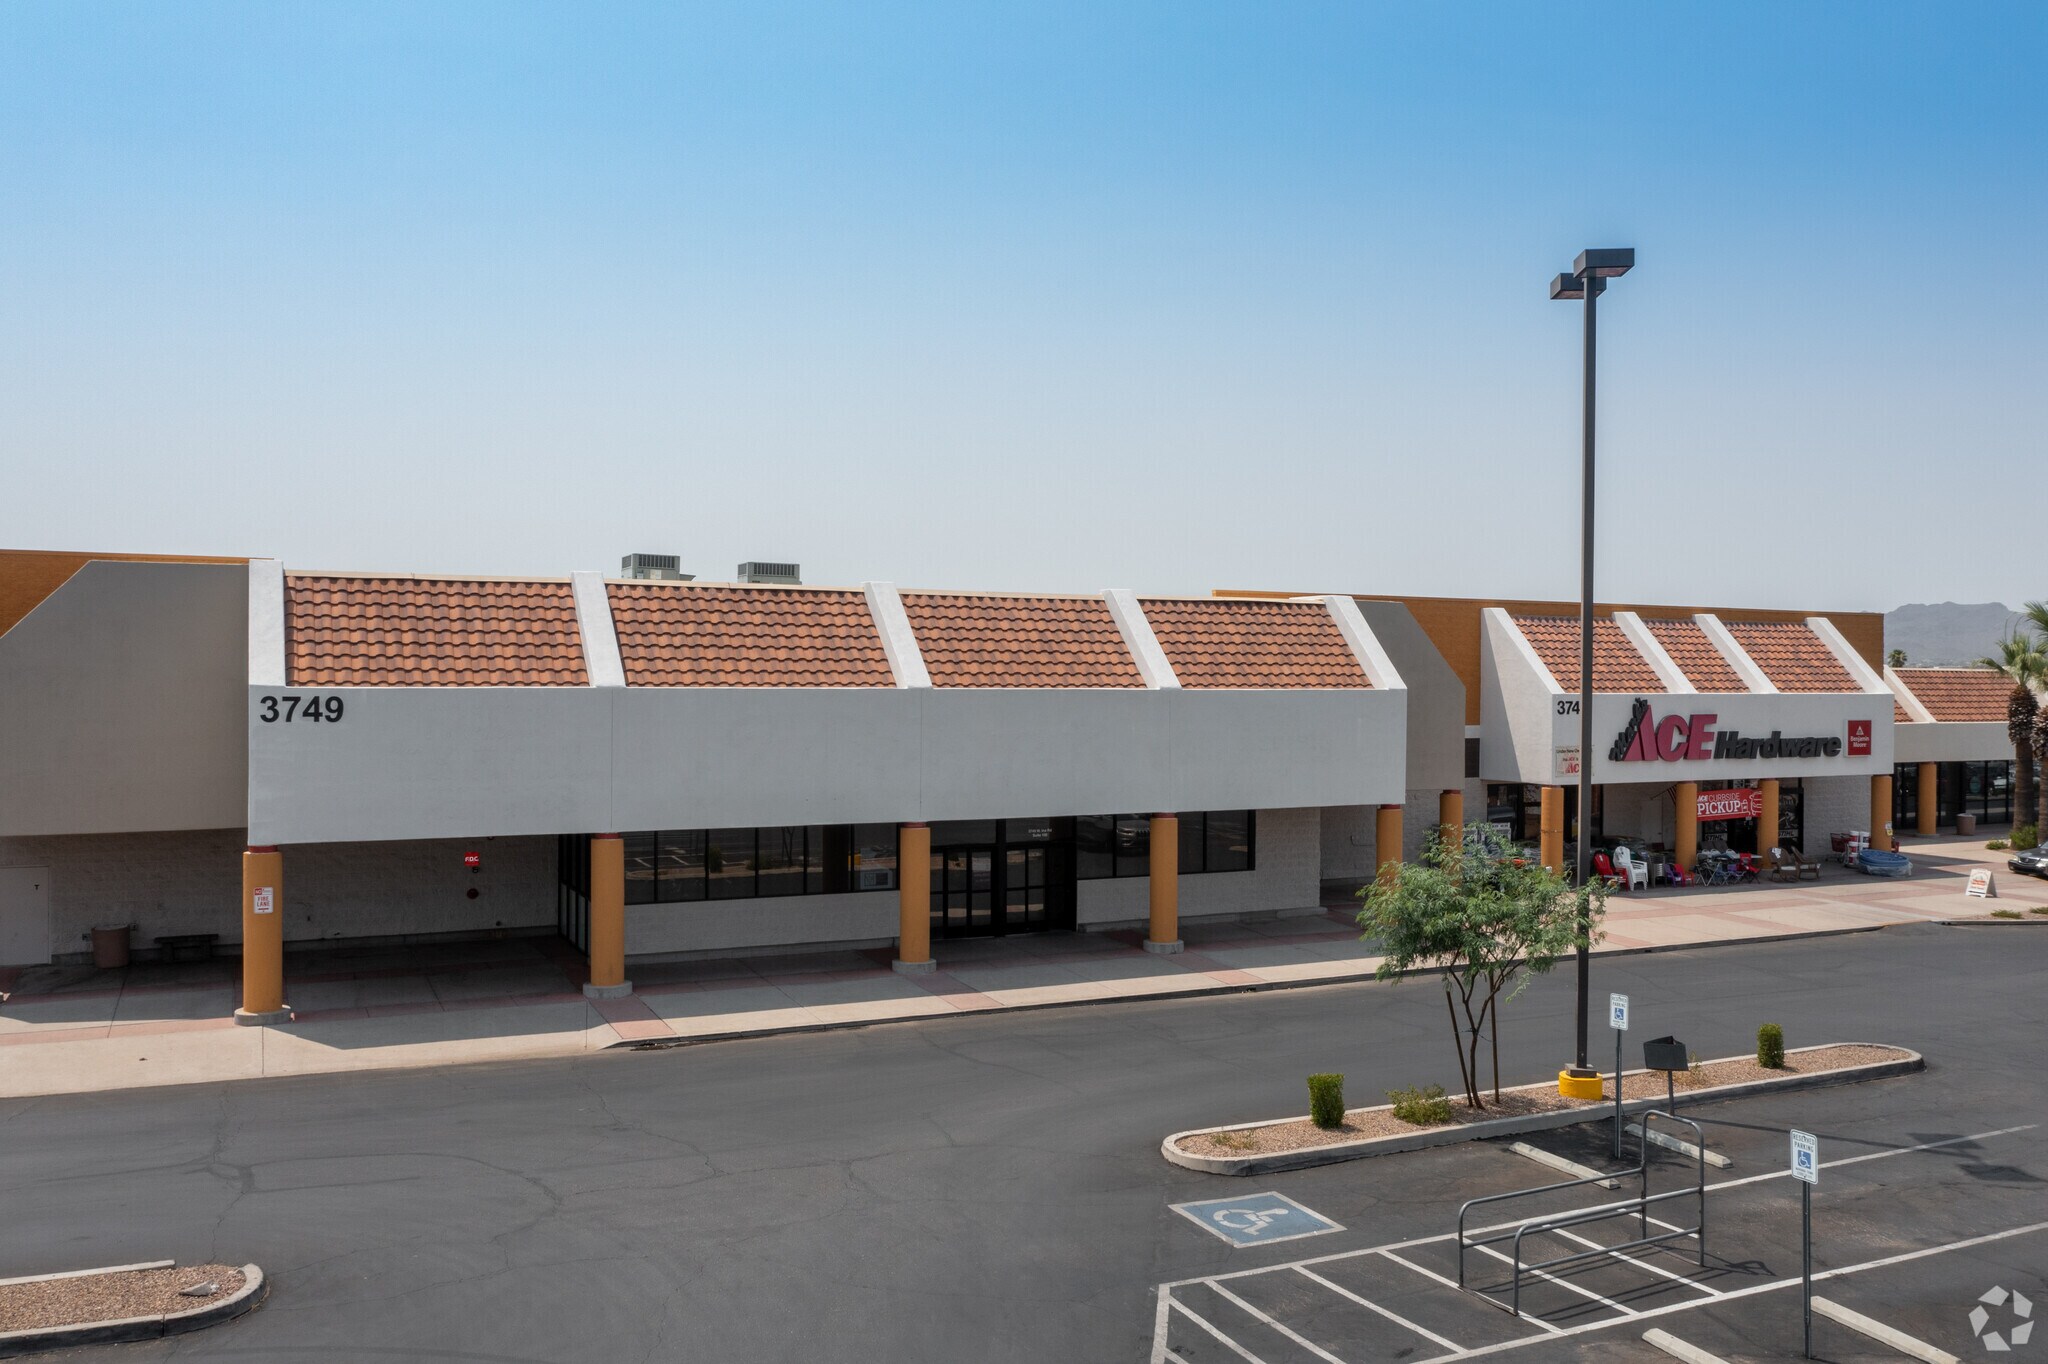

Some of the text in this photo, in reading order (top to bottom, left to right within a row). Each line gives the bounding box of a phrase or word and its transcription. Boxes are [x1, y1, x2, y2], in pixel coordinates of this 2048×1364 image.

[260, 696, 344, 723] 3749
[1557, 700, 1581, 715] 374
[1621, 704, 1718, 762] ACE
[1714, 731, 1842, 759] Hardware
[1565, 763, 1580, 773] AC
[1709, 793, 1740, 802] CURBSIDE
[1697, 800, 1741, 815] PICKUP
[1793, 1133, 1815, 1145] RESERVED
[1794, 1141, 1814, 1152] PARKING
